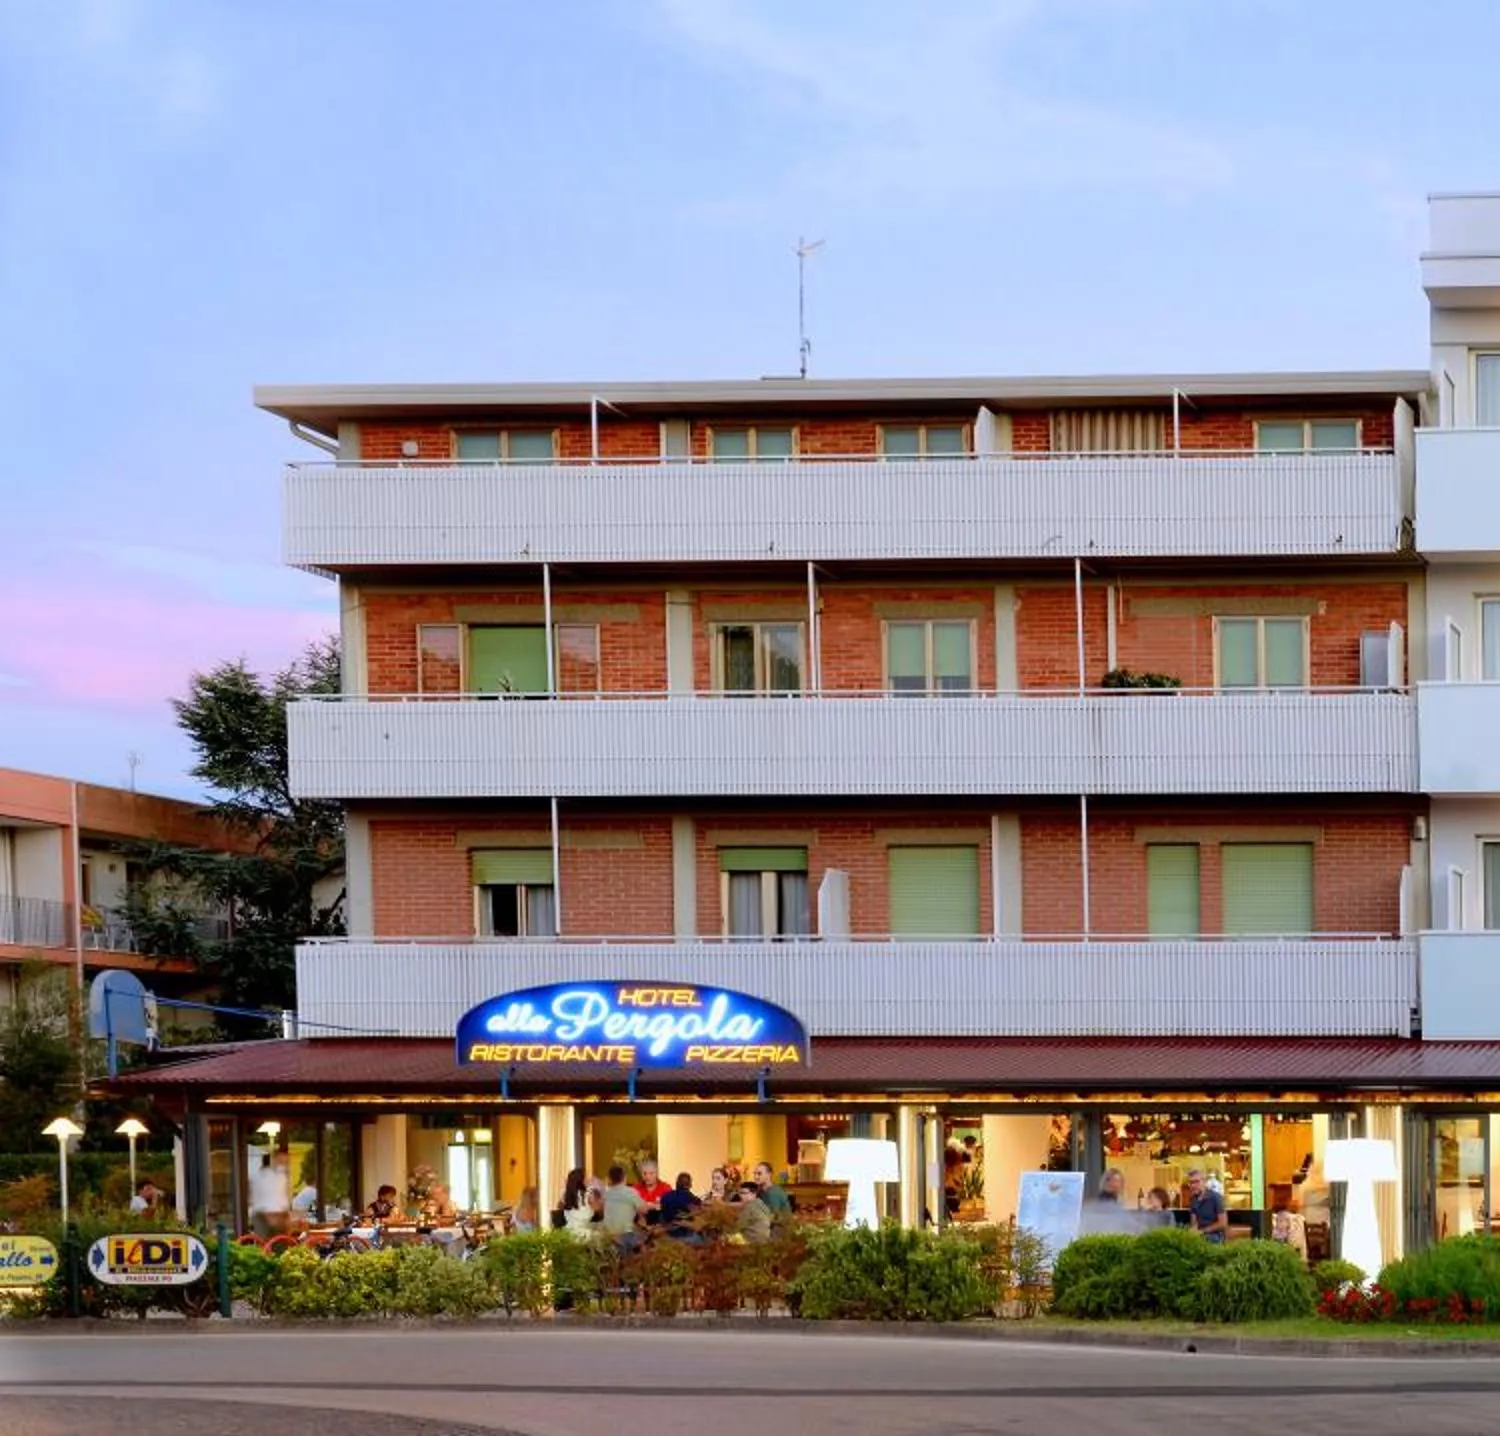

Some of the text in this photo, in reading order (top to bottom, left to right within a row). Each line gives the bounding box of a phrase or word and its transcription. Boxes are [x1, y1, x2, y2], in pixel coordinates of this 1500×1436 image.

[618, 988, 702, 1007] HOTEL
[487, 991, 763, 1056] alla Pergola
[469, 1044, 799, 1062] RISTORANTE PIZZERIA
